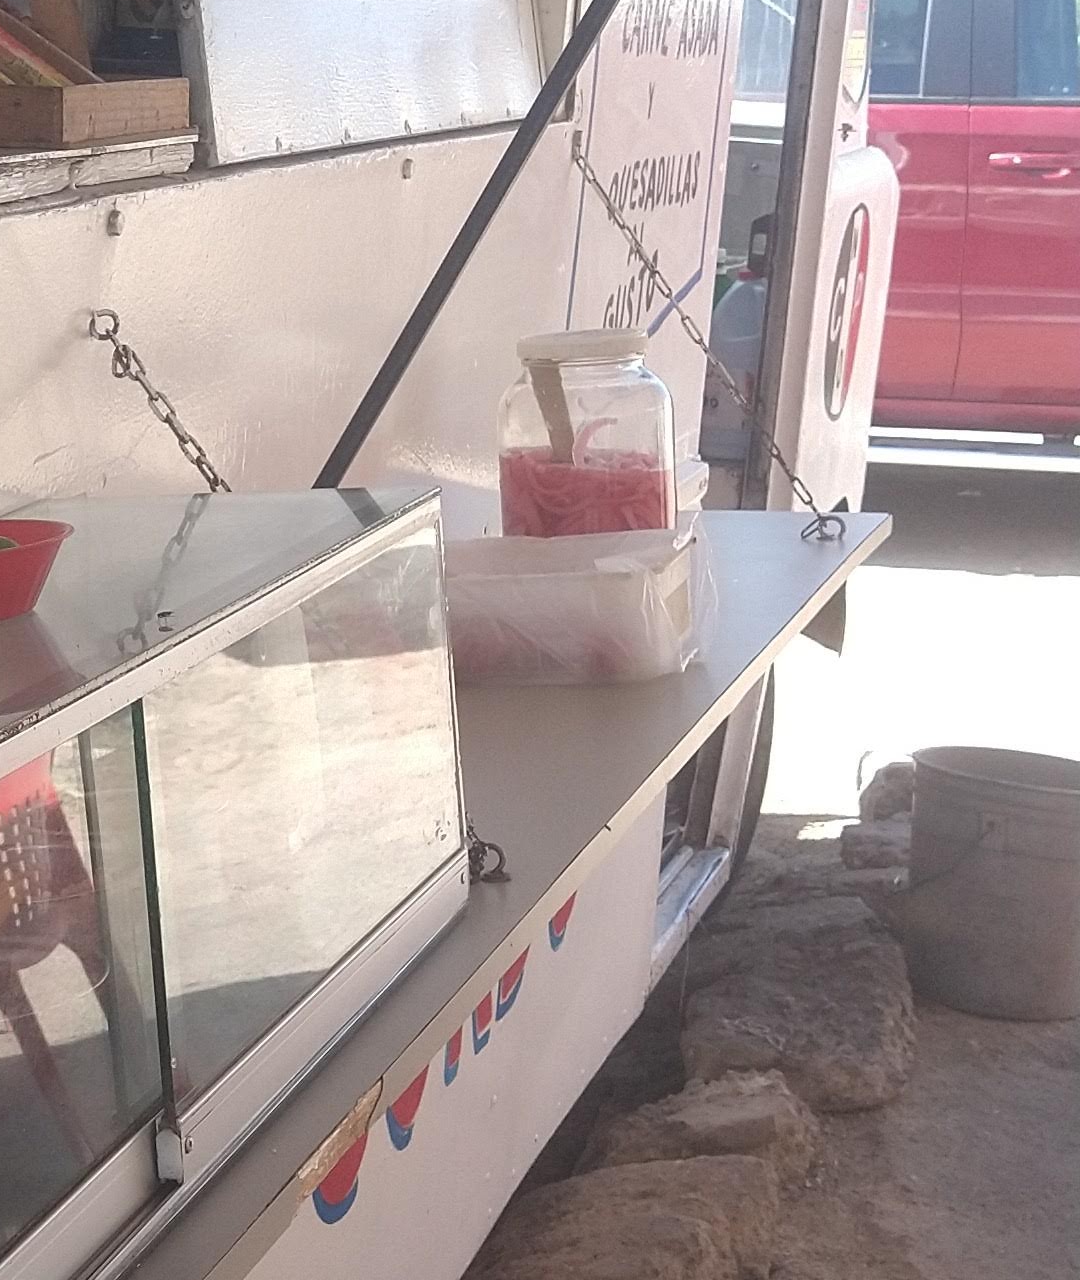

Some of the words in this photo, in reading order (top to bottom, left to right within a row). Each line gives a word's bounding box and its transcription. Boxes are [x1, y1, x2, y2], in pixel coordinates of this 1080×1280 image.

[647, 80, 656, 121] Y
[608, 150, 700, 226] QUESADILLAS
[603, 248, 659, 329] GUSTO
